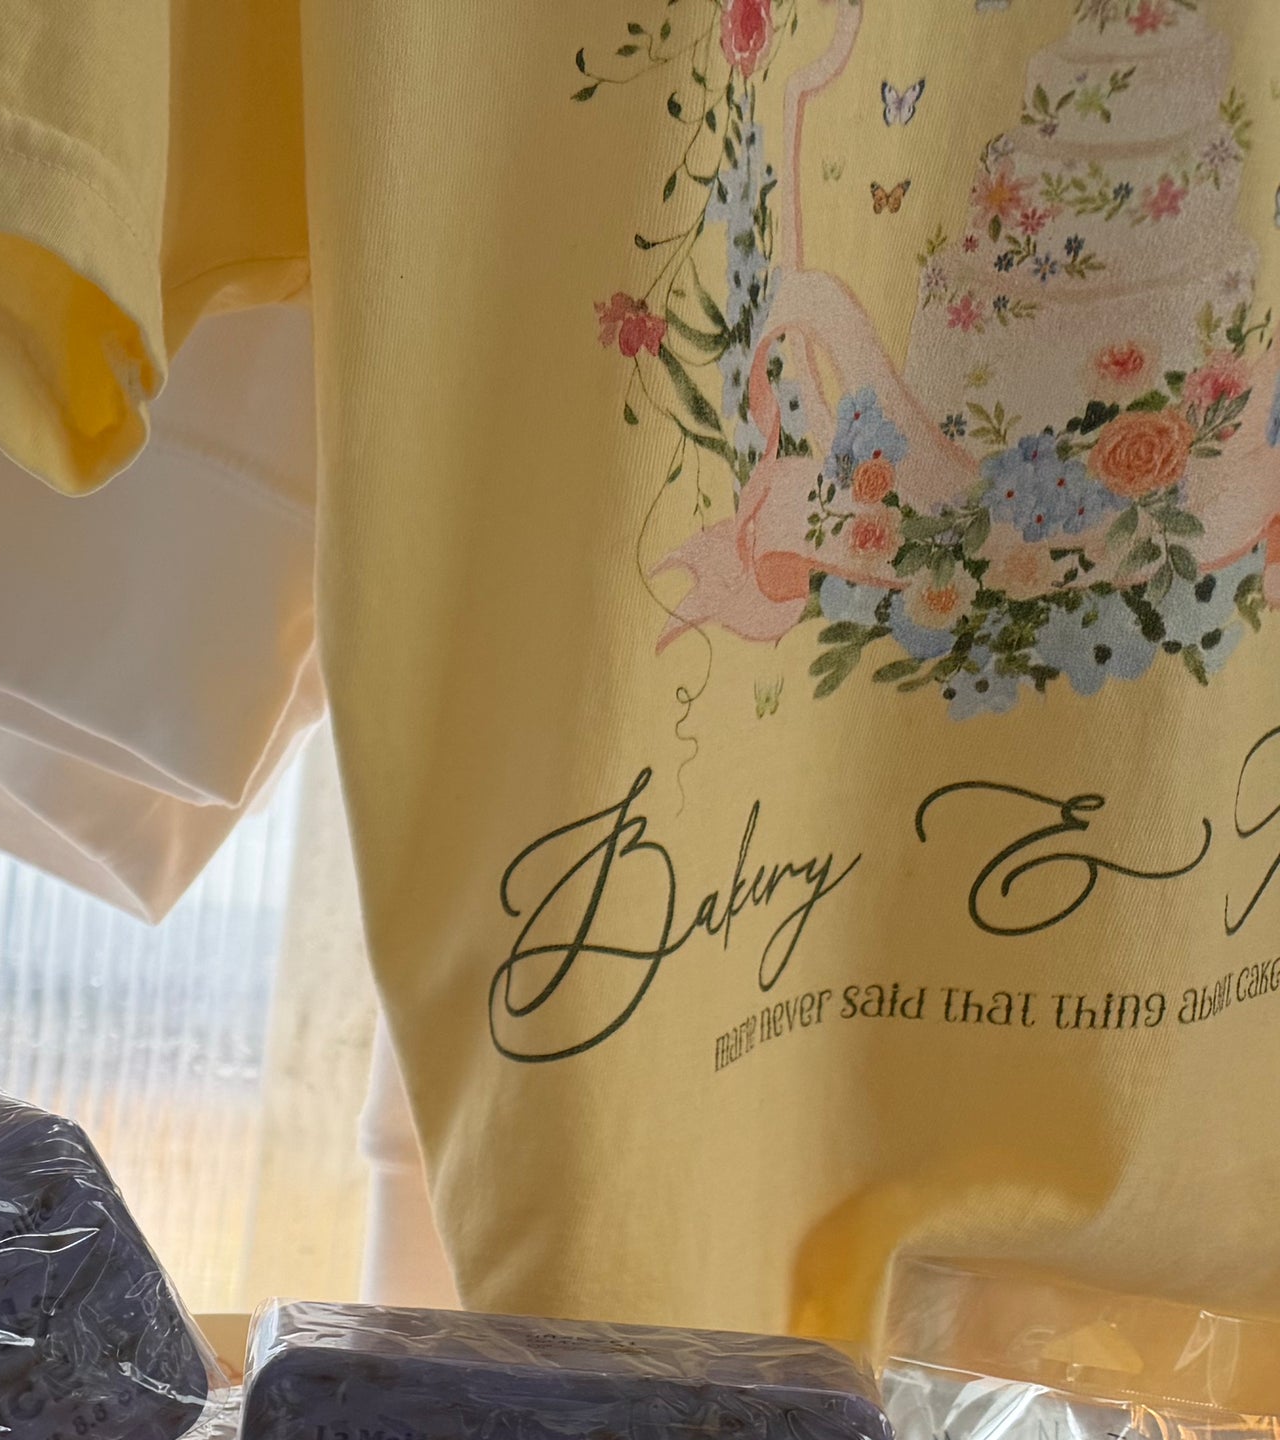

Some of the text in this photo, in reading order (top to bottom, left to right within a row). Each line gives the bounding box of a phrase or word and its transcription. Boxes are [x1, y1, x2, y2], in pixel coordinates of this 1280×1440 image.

[488, 766, 863, 1063] Bakery
[759, 988, 833, 1043] never
[840, 982, 929, 1021] said
[940, 986, 1037, 1028] that
[1050, 992, 1167, 1030] thing
